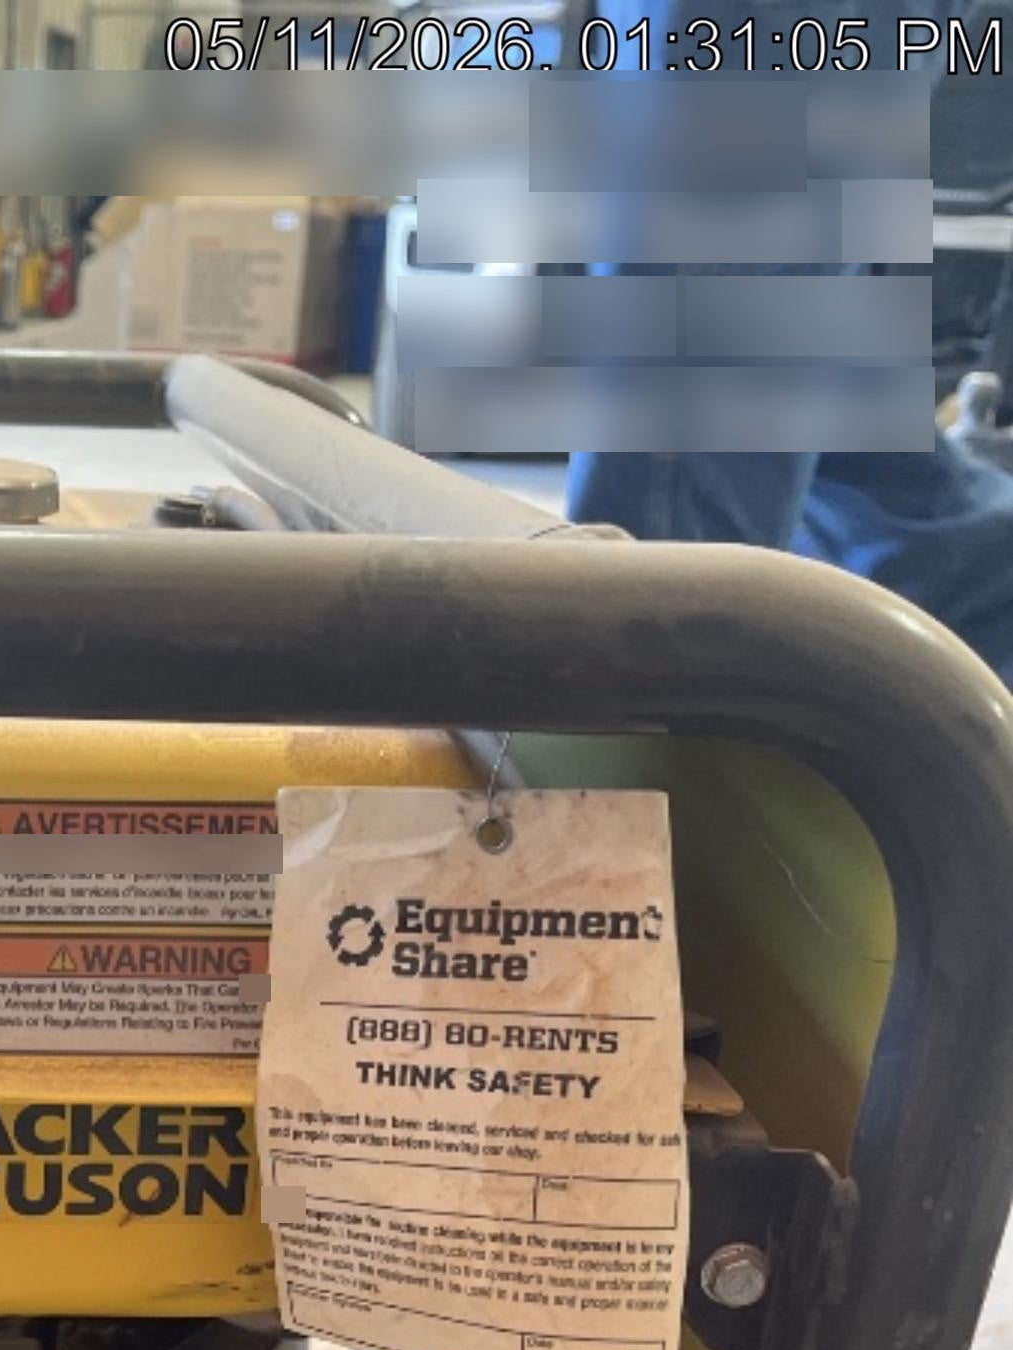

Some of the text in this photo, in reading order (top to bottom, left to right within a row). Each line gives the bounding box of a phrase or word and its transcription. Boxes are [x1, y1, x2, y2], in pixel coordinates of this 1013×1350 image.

[13, 811, 278, 834] AVERTISSEMEN
[394, 898, 662, 946] Equipment
[80, 944, 253, 974] WARNING
[391, 940, 529, 982] Share
[346, 1016, 619, 1056] (888) 80-RENTS
[355, 1060, 601, 1099] THINK SAFETY
